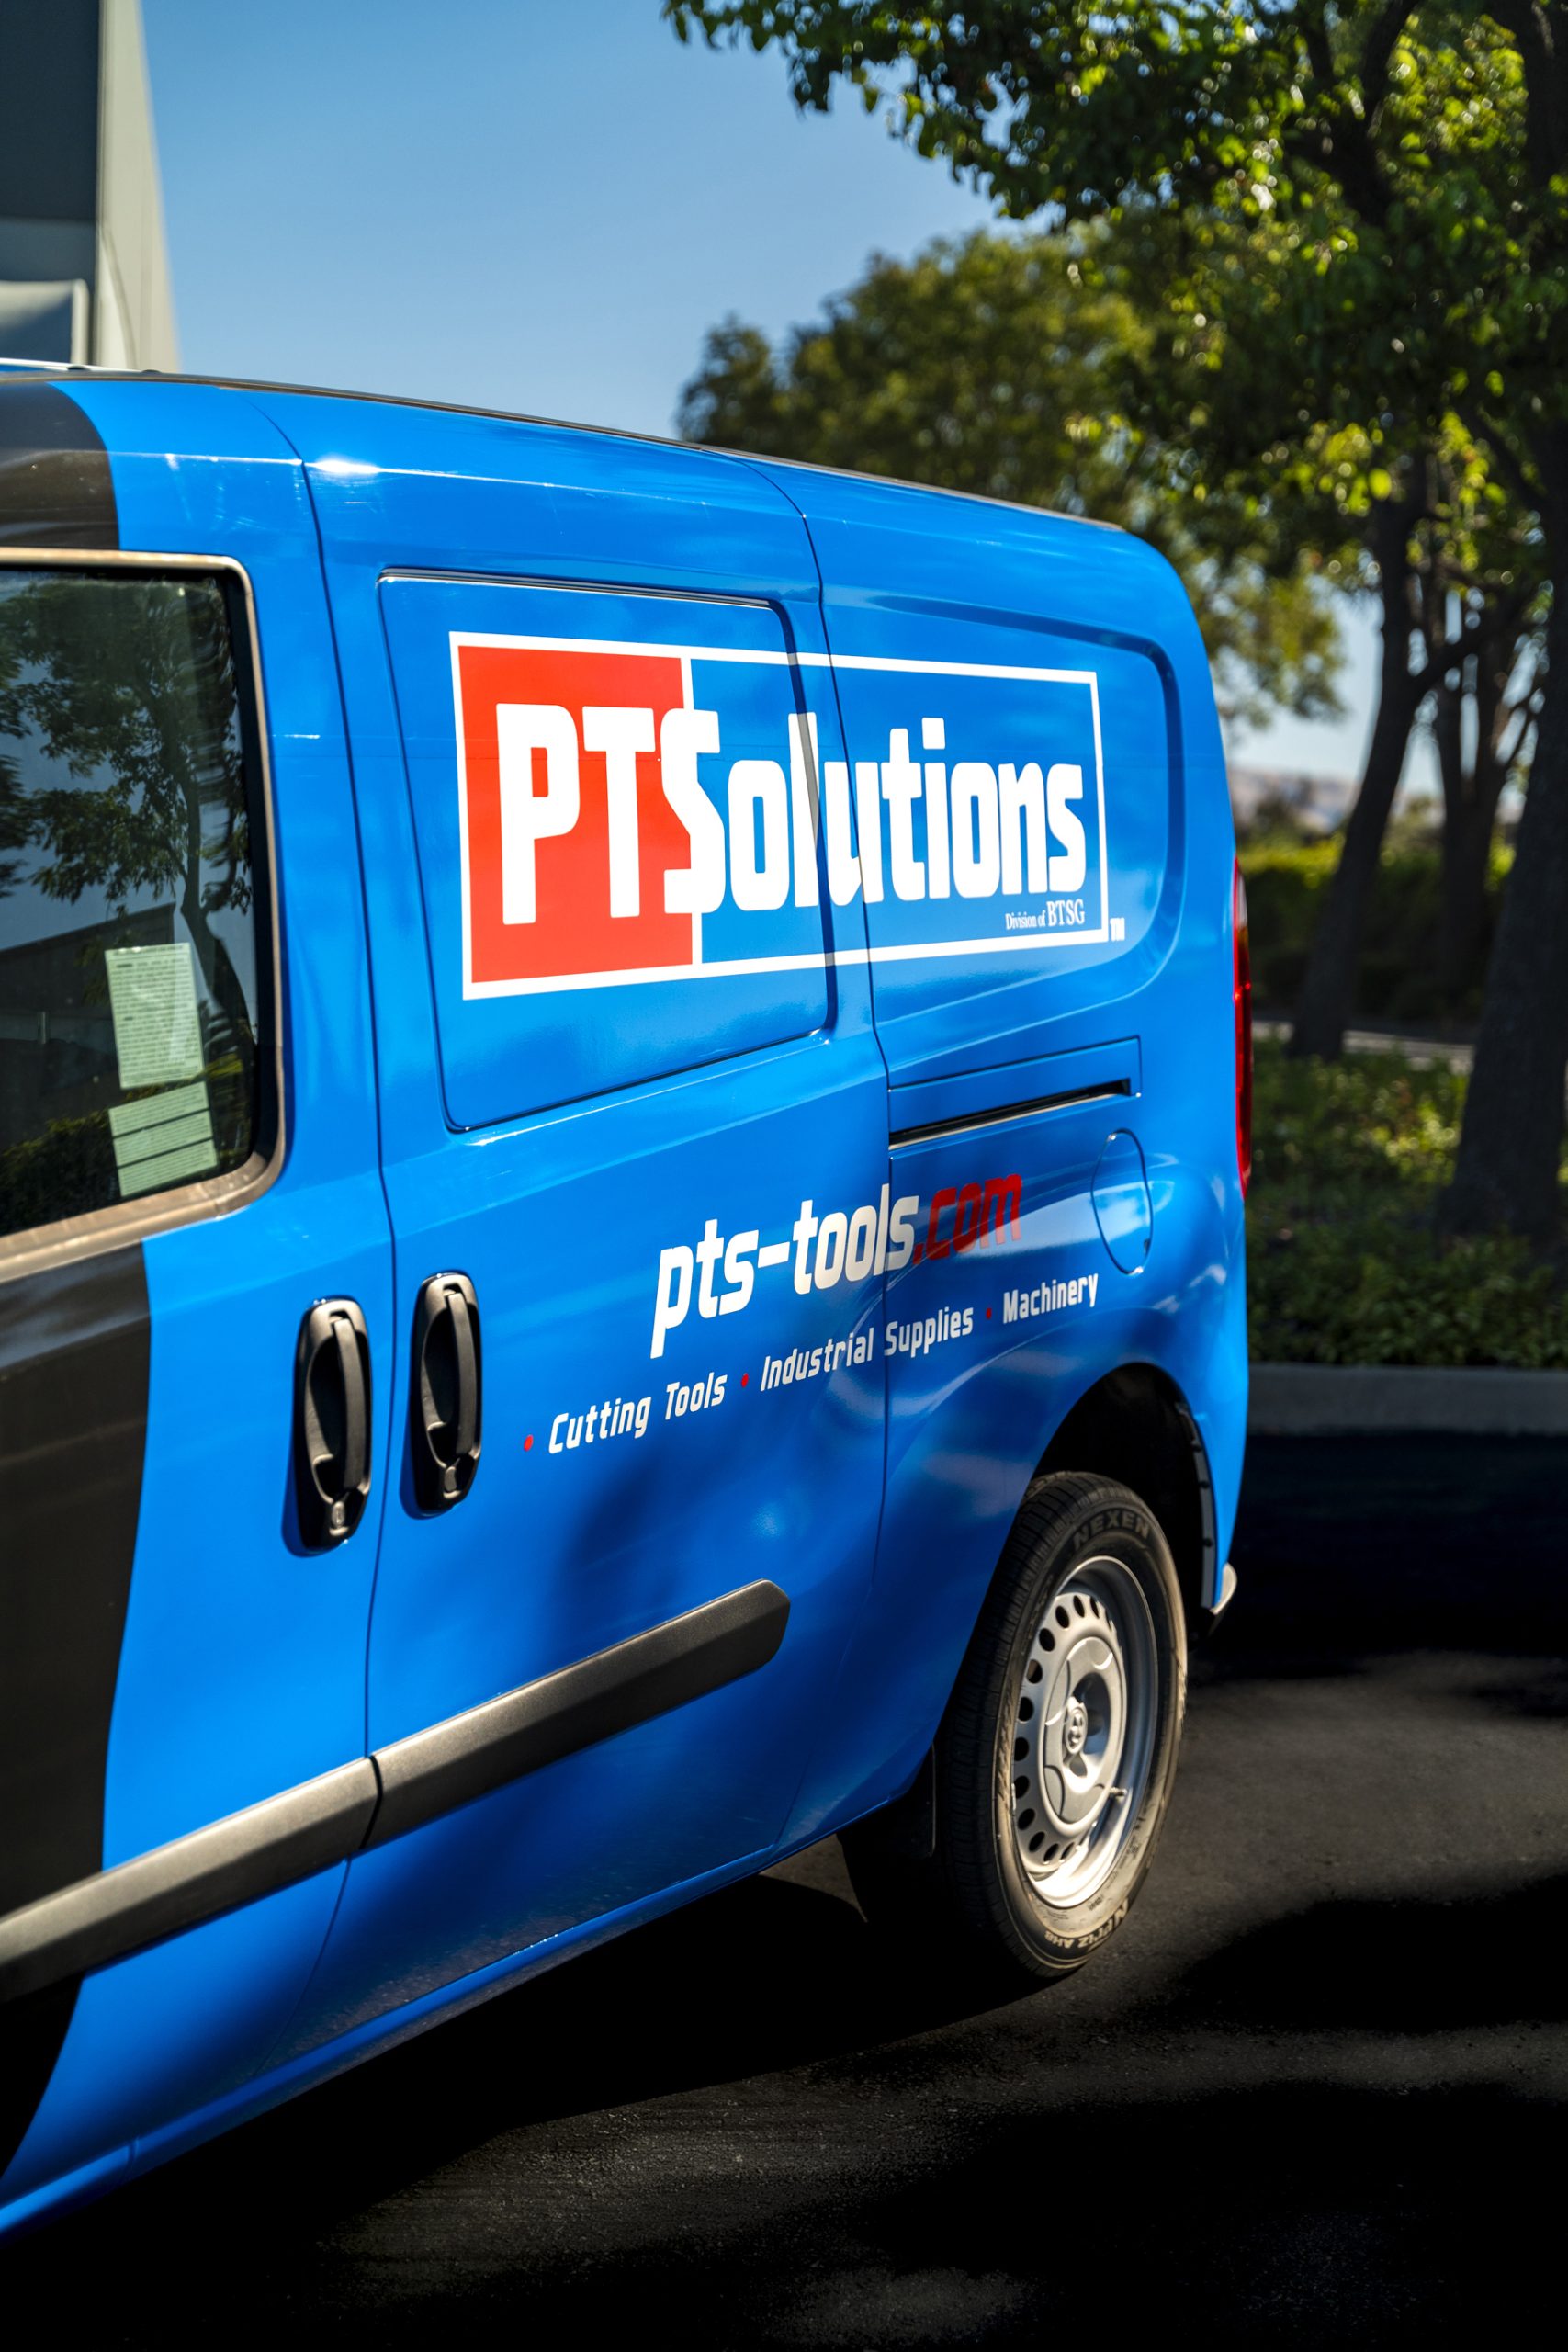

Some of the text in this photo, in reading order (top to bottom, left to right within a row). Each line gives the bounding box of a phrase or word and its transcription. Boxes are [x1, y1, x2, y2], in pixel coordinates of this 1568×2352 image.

[495, 702, 1085, 925] PTSolutions
[1005, 899, 1085, 930] Division of BTSG
[649, 1172, 1023, 1359] pts-tools.com
[548, 1272, 1100, 1454] Cutting Tools Industrial Supplies Machinery
[1073, 1510, 1150, 1552] NEXEN
